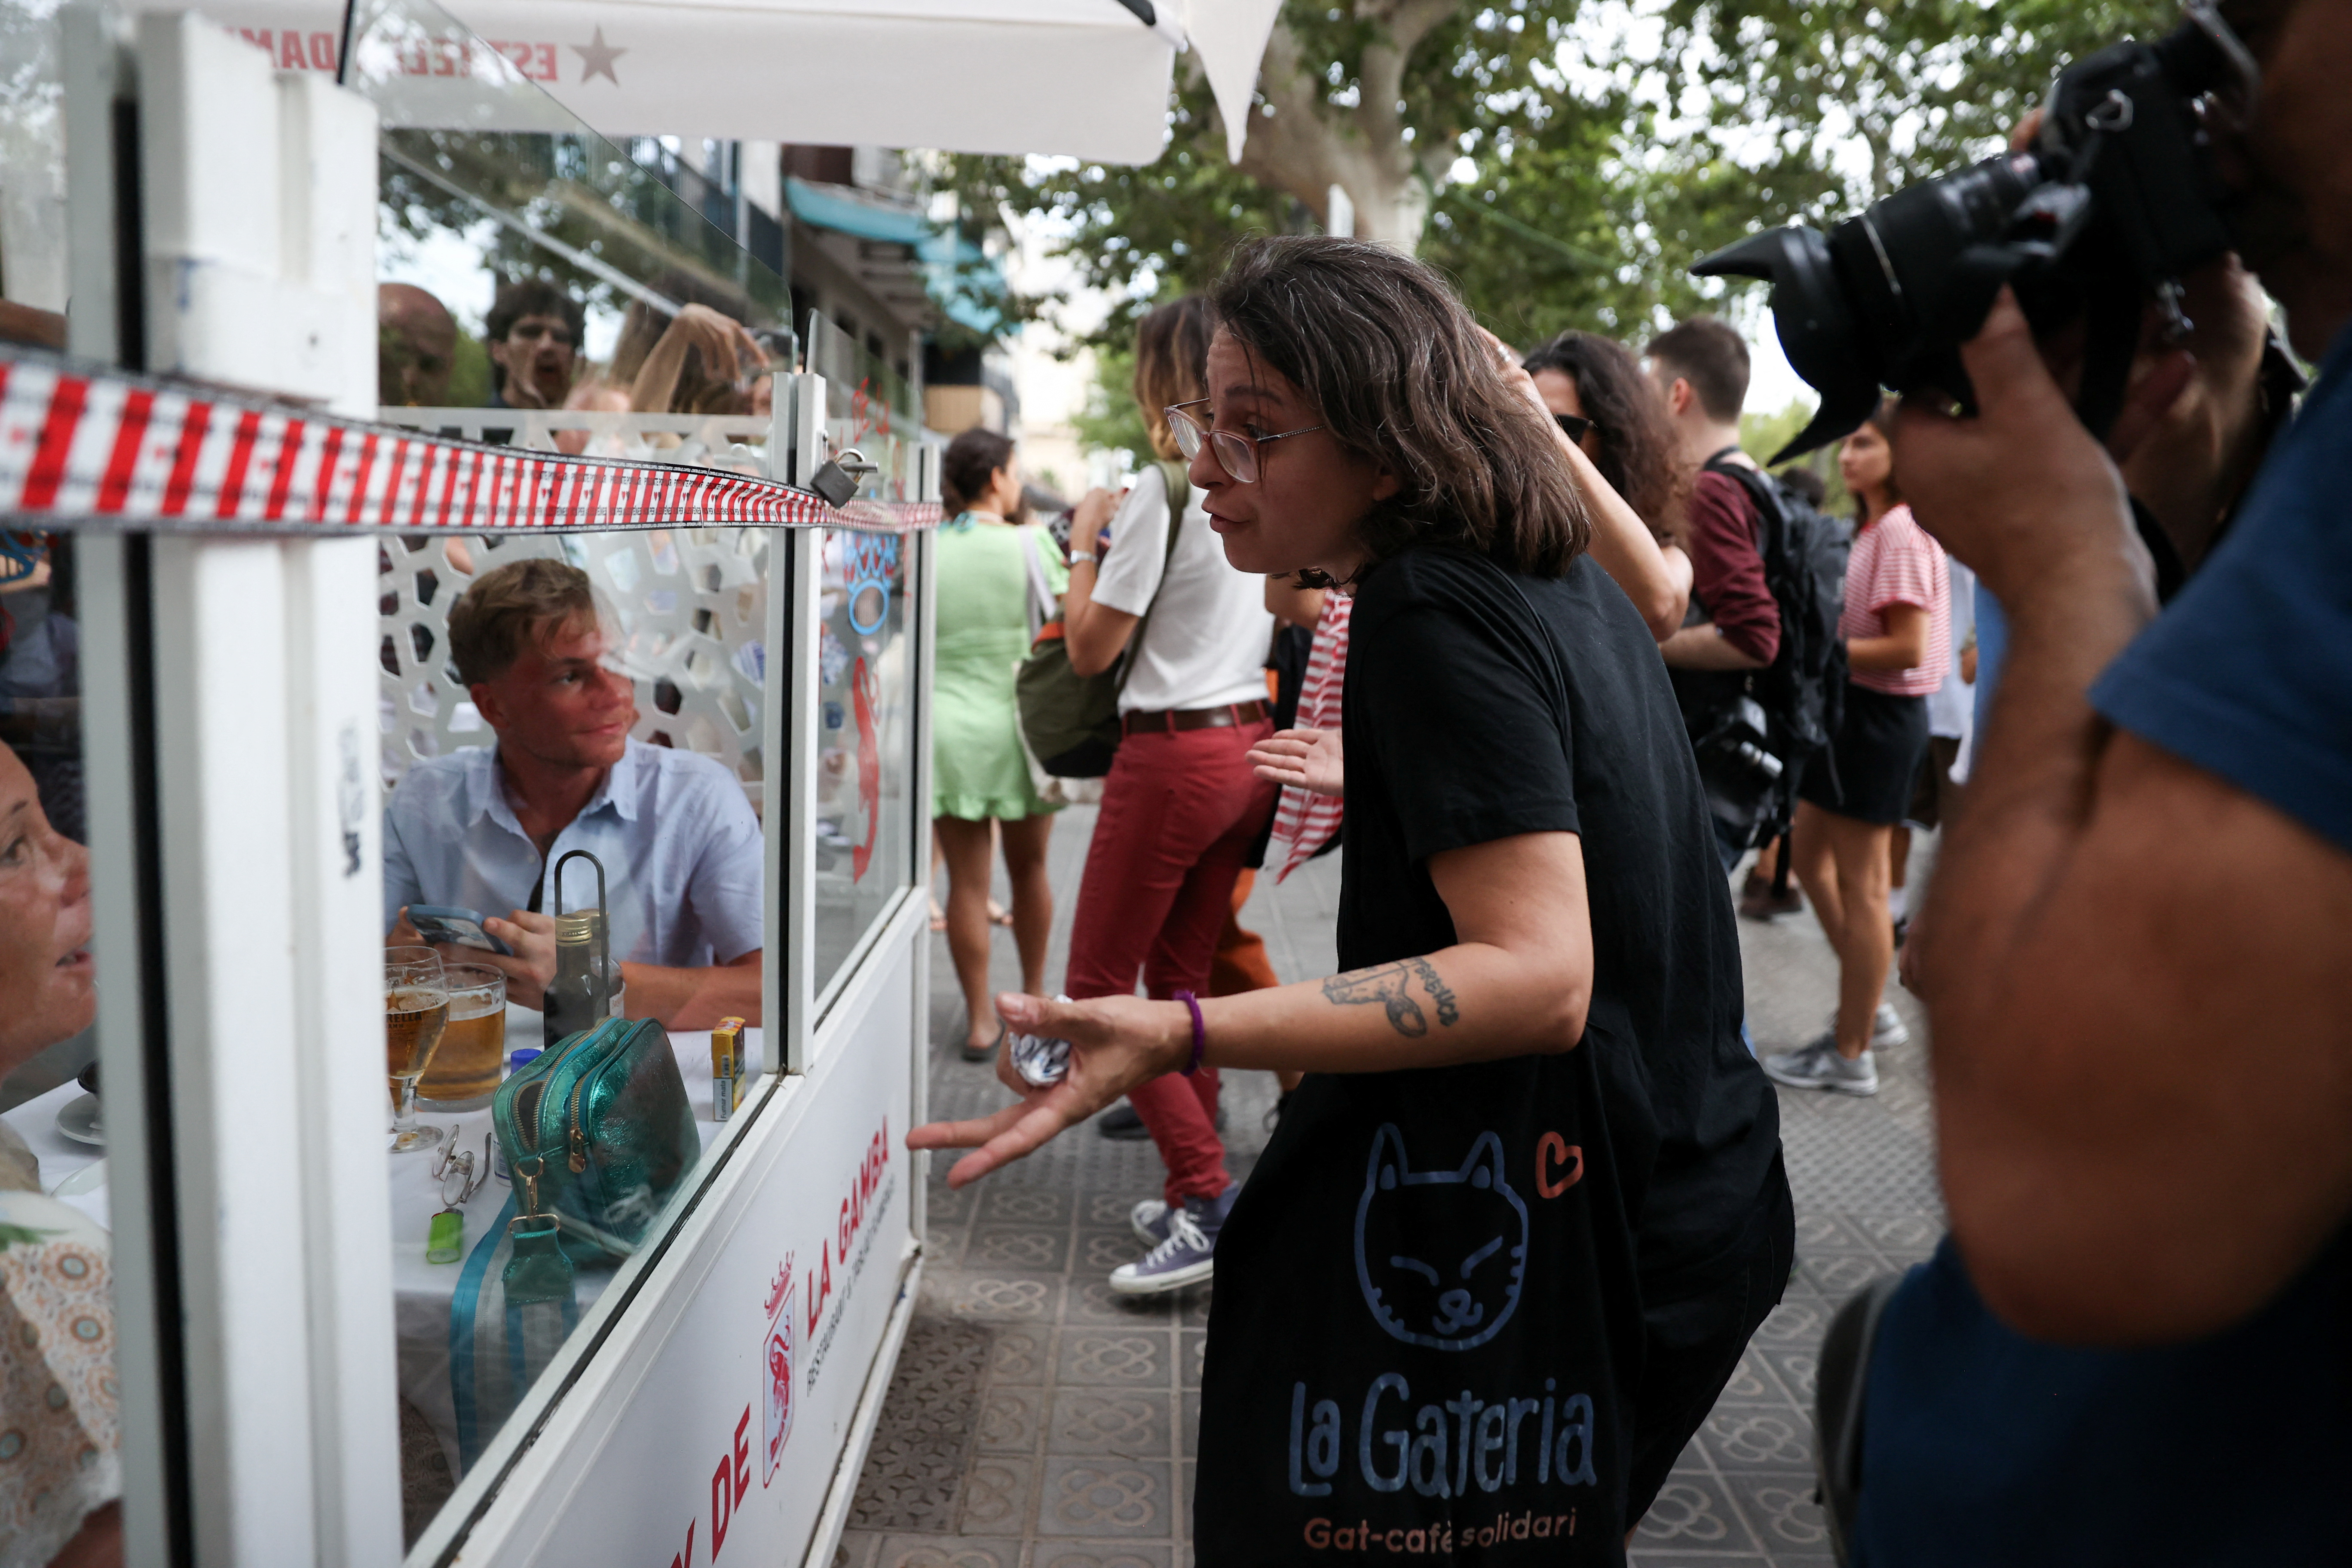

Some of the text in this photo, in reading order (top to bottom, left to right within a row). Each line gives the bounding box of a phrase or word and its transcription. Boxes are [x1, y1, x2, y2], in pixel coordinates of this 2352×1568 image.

[712, 1403, 750, 1566] DE
[807, 1237, 831, 1342] LA
[839, 1114, 889, 1265] GAMBA
[1289, 1372, 1597, 1499] La Gateria
[1461, 1507, 1576, 1547] solidari
